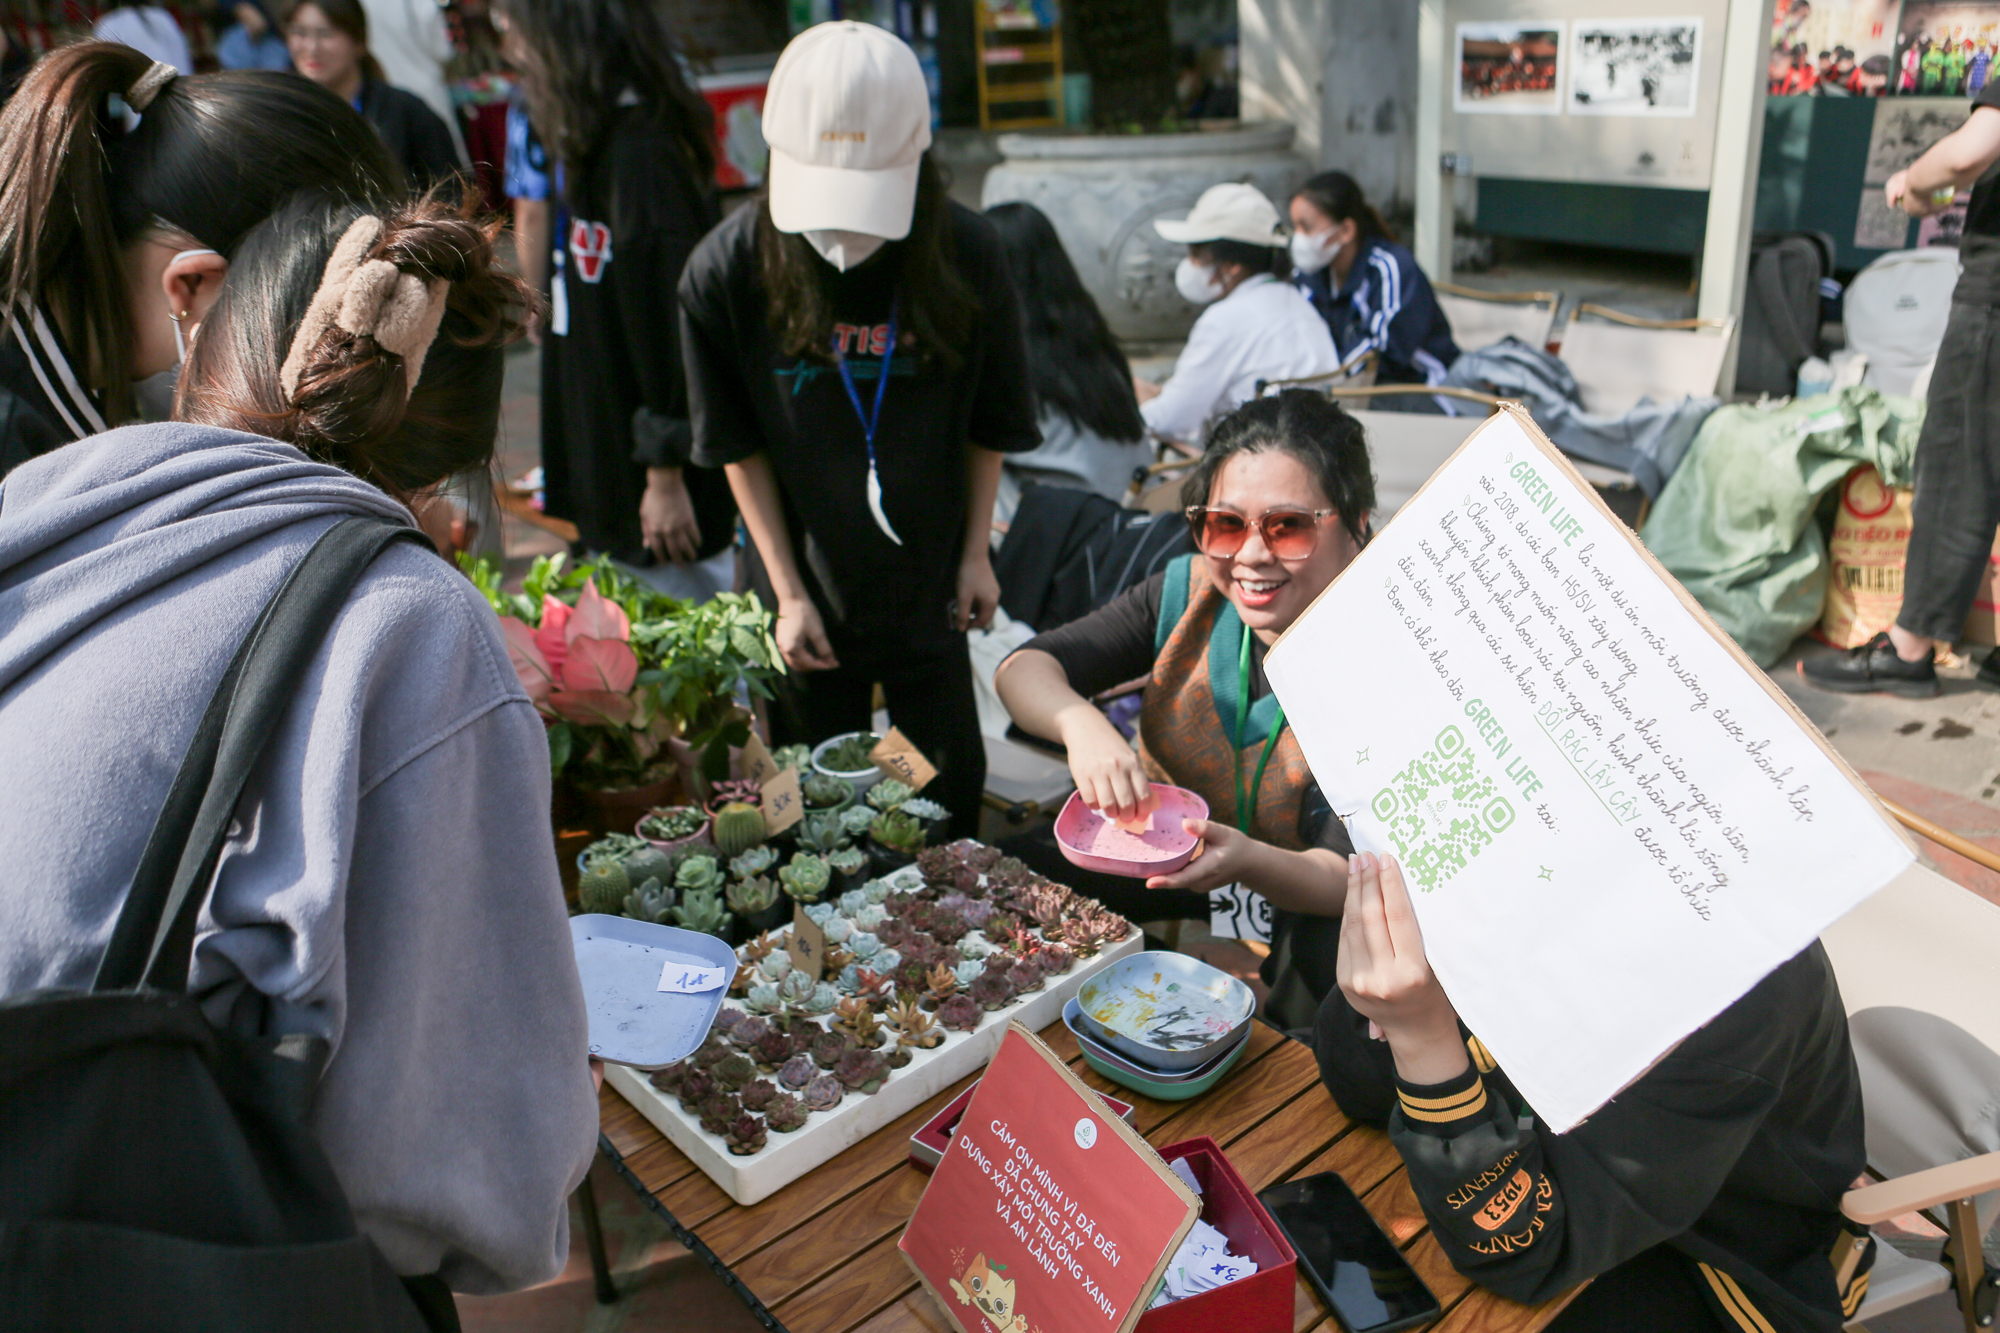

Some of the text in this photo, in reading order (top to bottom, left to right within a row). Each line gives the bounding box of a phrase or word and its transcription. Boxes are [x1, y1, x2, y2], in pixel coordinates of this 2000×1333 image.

[1386, 584, 1406, 617] Bạn
[1397, 555, 1416, 581] đều
[1478, 475, 1496, 495] vào
[1515, 520, 1530, 537] do
[1525, 535, 1542, 555] các
[1540, 546, 1560, 579] bạn
[1560, 574, 1597, 614] HS/SV
[1587, 615, 1610, 649] xây
[1607, 638, 1639, 683] dựng.
[1403, 615, 1422, 630] có
[1412, 625, 1438, 651] thể
[1509, 460, 1559, 515] GREEN
[1548, 506, 1585, 548] LIFE
[1577, 542, 1596, 568] là
[1591, 566, 1615, 592] một
[1610, 589, 1629, 609] dự
[1624, 606, 1640, 627] án
[1640, 626, 1669, 656] môi
[1666, 654, 1710, 712] trường,
[1712, 708, 1744, 743] được
[1786, 784, 1814, 823] lập
[1428, 649, 1449, 679] theo
[1446, 677, 1465, 702] dõi
[1466, 502, 1749, 864] Chúng tớ mong muốn nâng cao nhận thức của người dân,
[1418, 538, 1711, 922] xanh, thông qua các sự kiện ĐỔI RÁC LẤY CÂY được tổ chức
[1438, 509, 1473, 559] khuyến
[1468, 552, 1501, 593] khích
[1486, 589, 1516, 623] phân
[1514, 614, 1538, 649] loại
[1532, 647, 1554, 672] rác
[1552, 668, 1571, 693] tại
[1565, 691, 1604, 742] nguồn,
[1606, 732, 1644, 775] hình
[1678, 818, 1702, 849] lối
[1693, 847, 1730, 894] sống
[1463, 698, 1513, 761] GREEN
[1504, 755, 1544, 803] LIFE
[959, 1135, 1117, 1321] DỰNG XÂY MÔI TRƯỜNG XANH
[990, 1119, 1121, 1268] CẢM ƠN MÌNH VÌ ĐÃ ĐẾN
[1004, 1158, 1085, 1251] ĐÃ CHUNG TAY
[1483, 1179, 1523, 1221] 1953
[996, 1198, 1060, 1280] VÀ AN LÀNH
